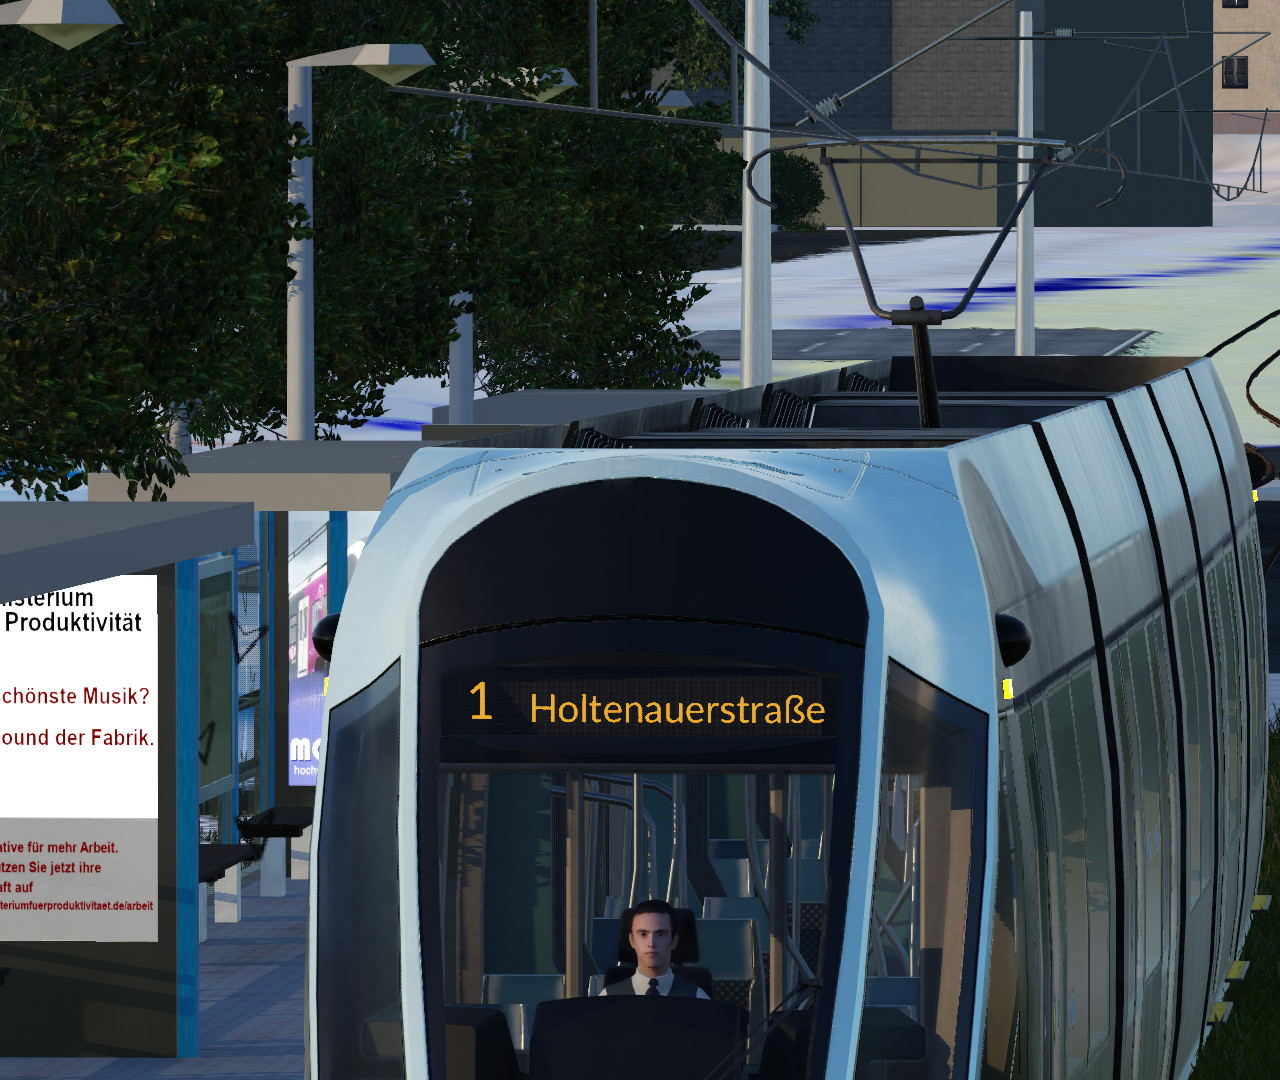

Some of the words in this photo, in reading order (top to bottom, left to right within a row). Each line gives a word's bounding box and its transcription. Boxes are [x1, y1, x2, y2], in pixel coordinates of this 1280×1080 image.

[6, 612, 141, 631] Produktivität
[84, 687, 149, 704] Musik?
[470, 682, 492, 719] 1
[532, 694, 825, 724] Holtenauerstraße
[56, 729, 85, 745] der
[92, 729, 153, 745] Fabrik.
[28, 841, 44, 852] für
[48, 842, 77, 853] mehr
[80, 842, 118, 853] Arbeit.
[29, 861, 46, 872] Sie
[50, 862, 75, 875] jetzt
[80, 862, 101, 873] ihre
[15, 881, 33, 892] auf
